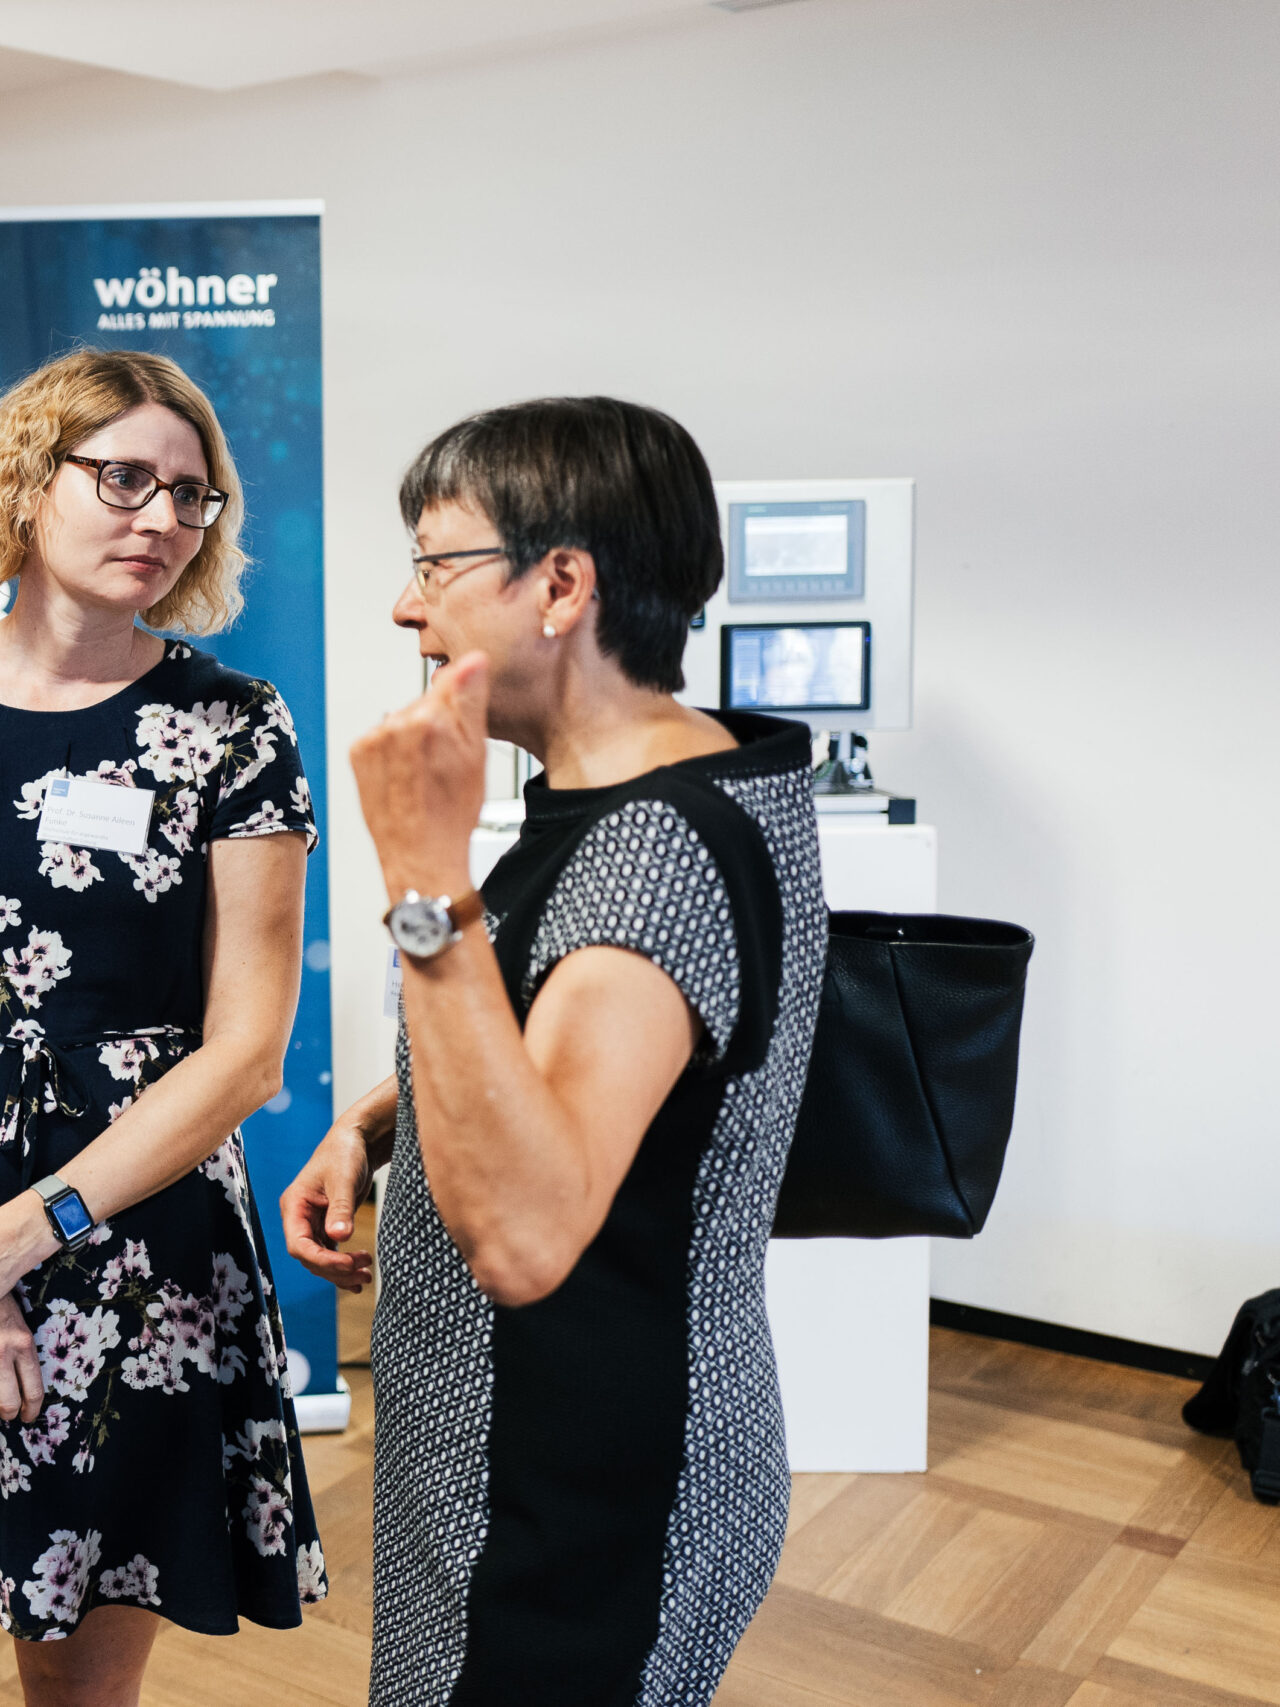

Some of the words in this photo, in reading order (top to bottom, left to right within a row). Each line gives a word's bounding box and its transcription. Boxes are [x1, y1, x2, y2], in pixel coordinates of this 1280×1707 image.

[93, 266, 278, 308] wöhner
[97, 312, 146, 331] ALLES
[148, 311, 181, 330] MIT
[182, 309, 276, 330] SPANNUNG
